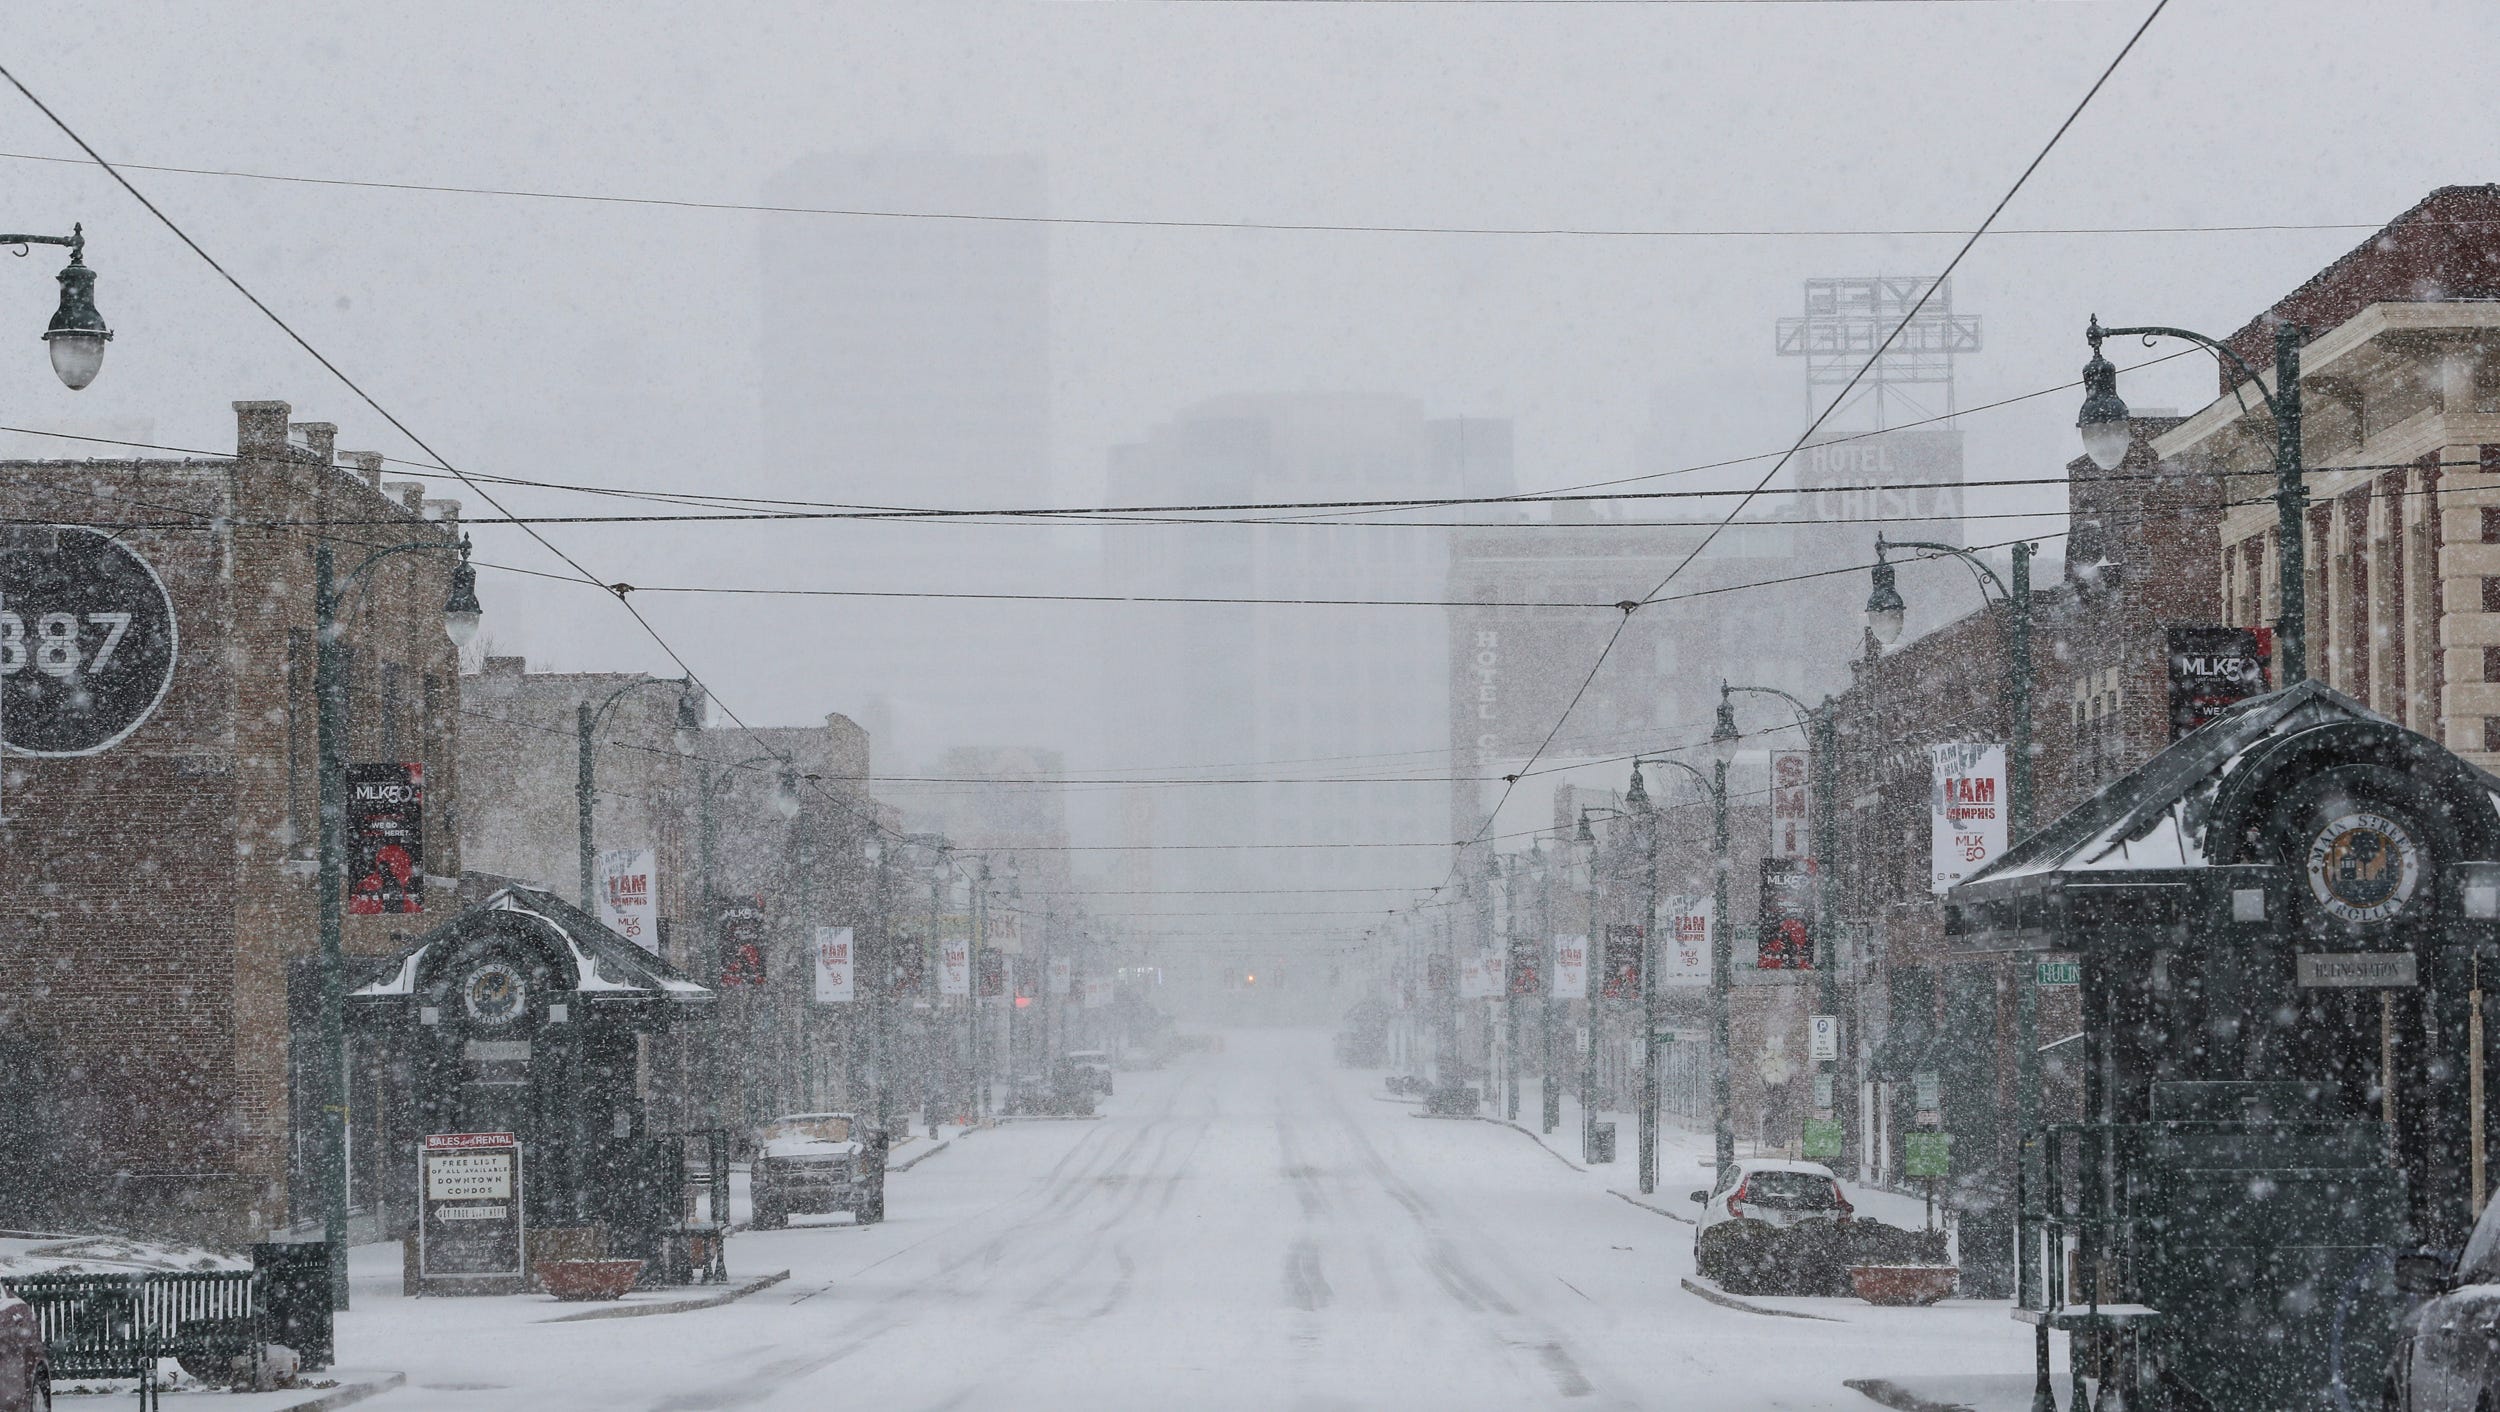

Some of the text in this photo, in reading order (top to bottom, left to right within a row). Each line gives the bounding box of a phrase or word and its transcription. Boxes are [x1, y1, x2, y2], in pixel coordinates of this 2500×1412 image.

[1812, 446, 1895, 473] HOTEL
[1816, 478, 1959, 521] CHISCA
[1477, 631, 1497, 719] HOTEL
[2183, 658, 2259, 681] MLK50
[2203, 707, 2220, 716] WE
[356, 786, 412, 804] MLK50
[1946, 778, 1995, 802] I AM
[1946, 807, 1995, 819] MEMPHIS
[372, 822, 398, 830] WE GO
[1956, 836, 1983, 847] MLK
[2312, 822, 2346, 862] MAIN
[1966, 847, 1985, 862] 50
[610, 874, 647, 894] I AM
[2323, 897, 2403, 921] TROLLEY
[618, 917, 639, 926] MLK
[1683, 916, 1705, 931] AM
[626, 926, 641, 937] 50
[829, 944, 847, 956] AM
[1680, 950, 1697, 958] MLK
[2357, 962, 2399, 977] STATION
[429, 1137, 460, 1146] SALES
[476, 1135, 512, 1145] RENTAL
[474, 1158, 497, 1166] LIST
[465, 1166, 508, 1174] AVAILABLE
[438, 1176, 502, 1185] DOWNTOWN
[447, 1186, 493, 1195] CONDOS
